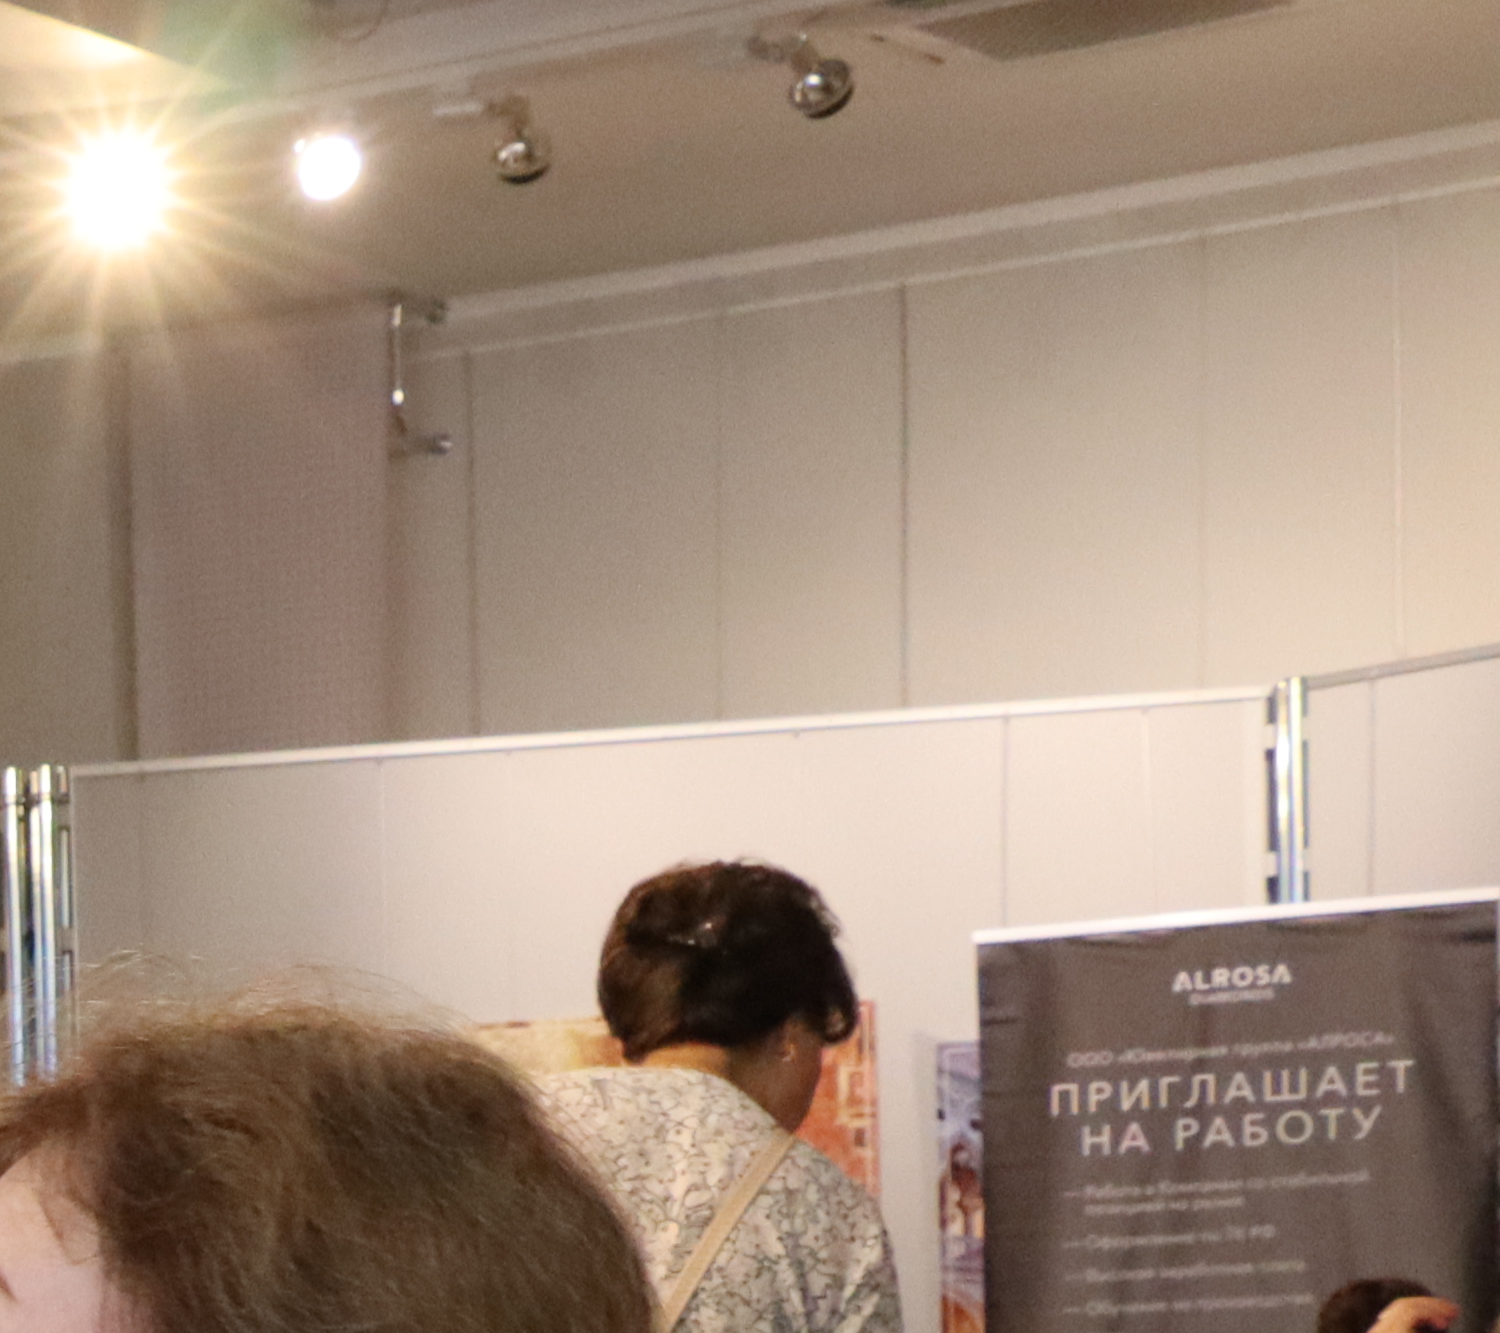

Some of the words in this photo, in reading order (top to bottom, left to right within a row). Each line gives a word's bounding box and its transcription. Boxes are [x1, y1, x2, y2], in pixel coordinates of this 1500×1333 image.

[1172, 963, 1293, 993] ALROSA
[1050, 1059, 1416, 1117] ПРИГЛАШАЕТ
[1081, 1122, 1151, 1157] НА
[1173, 1104, 1383, 1152] РАБОТУ
